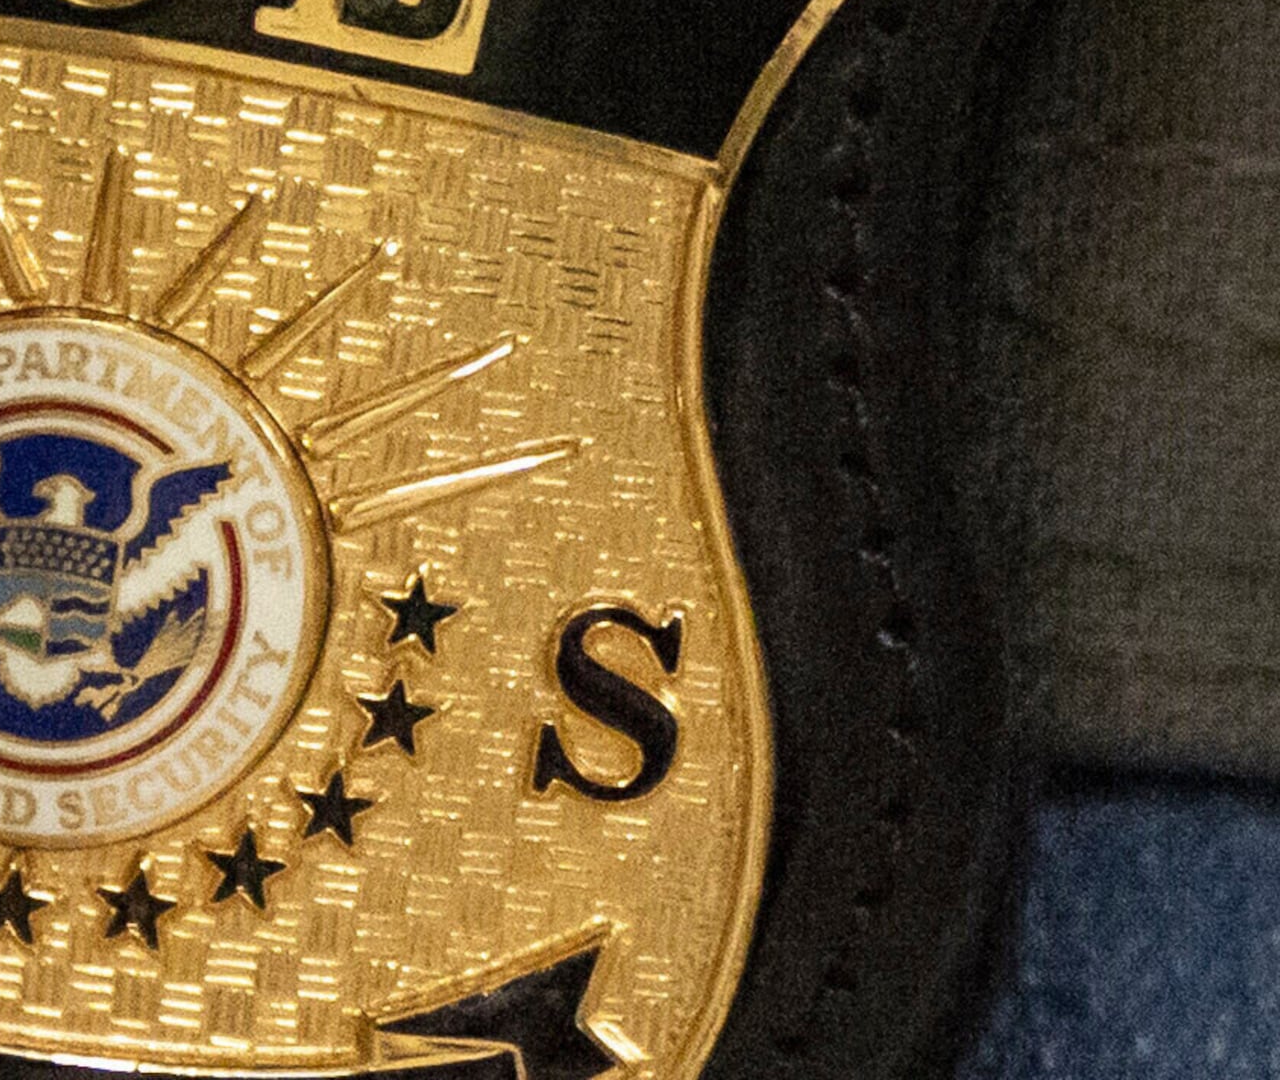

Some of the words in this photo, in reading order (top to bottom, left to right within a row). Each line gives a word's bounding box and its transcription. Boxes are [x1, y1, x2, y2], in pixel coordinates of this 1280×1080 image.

[245, 500, 293, 581] OF
[56, 630, 290, 830] SECURITY
[532, 606, 684, 802] S
